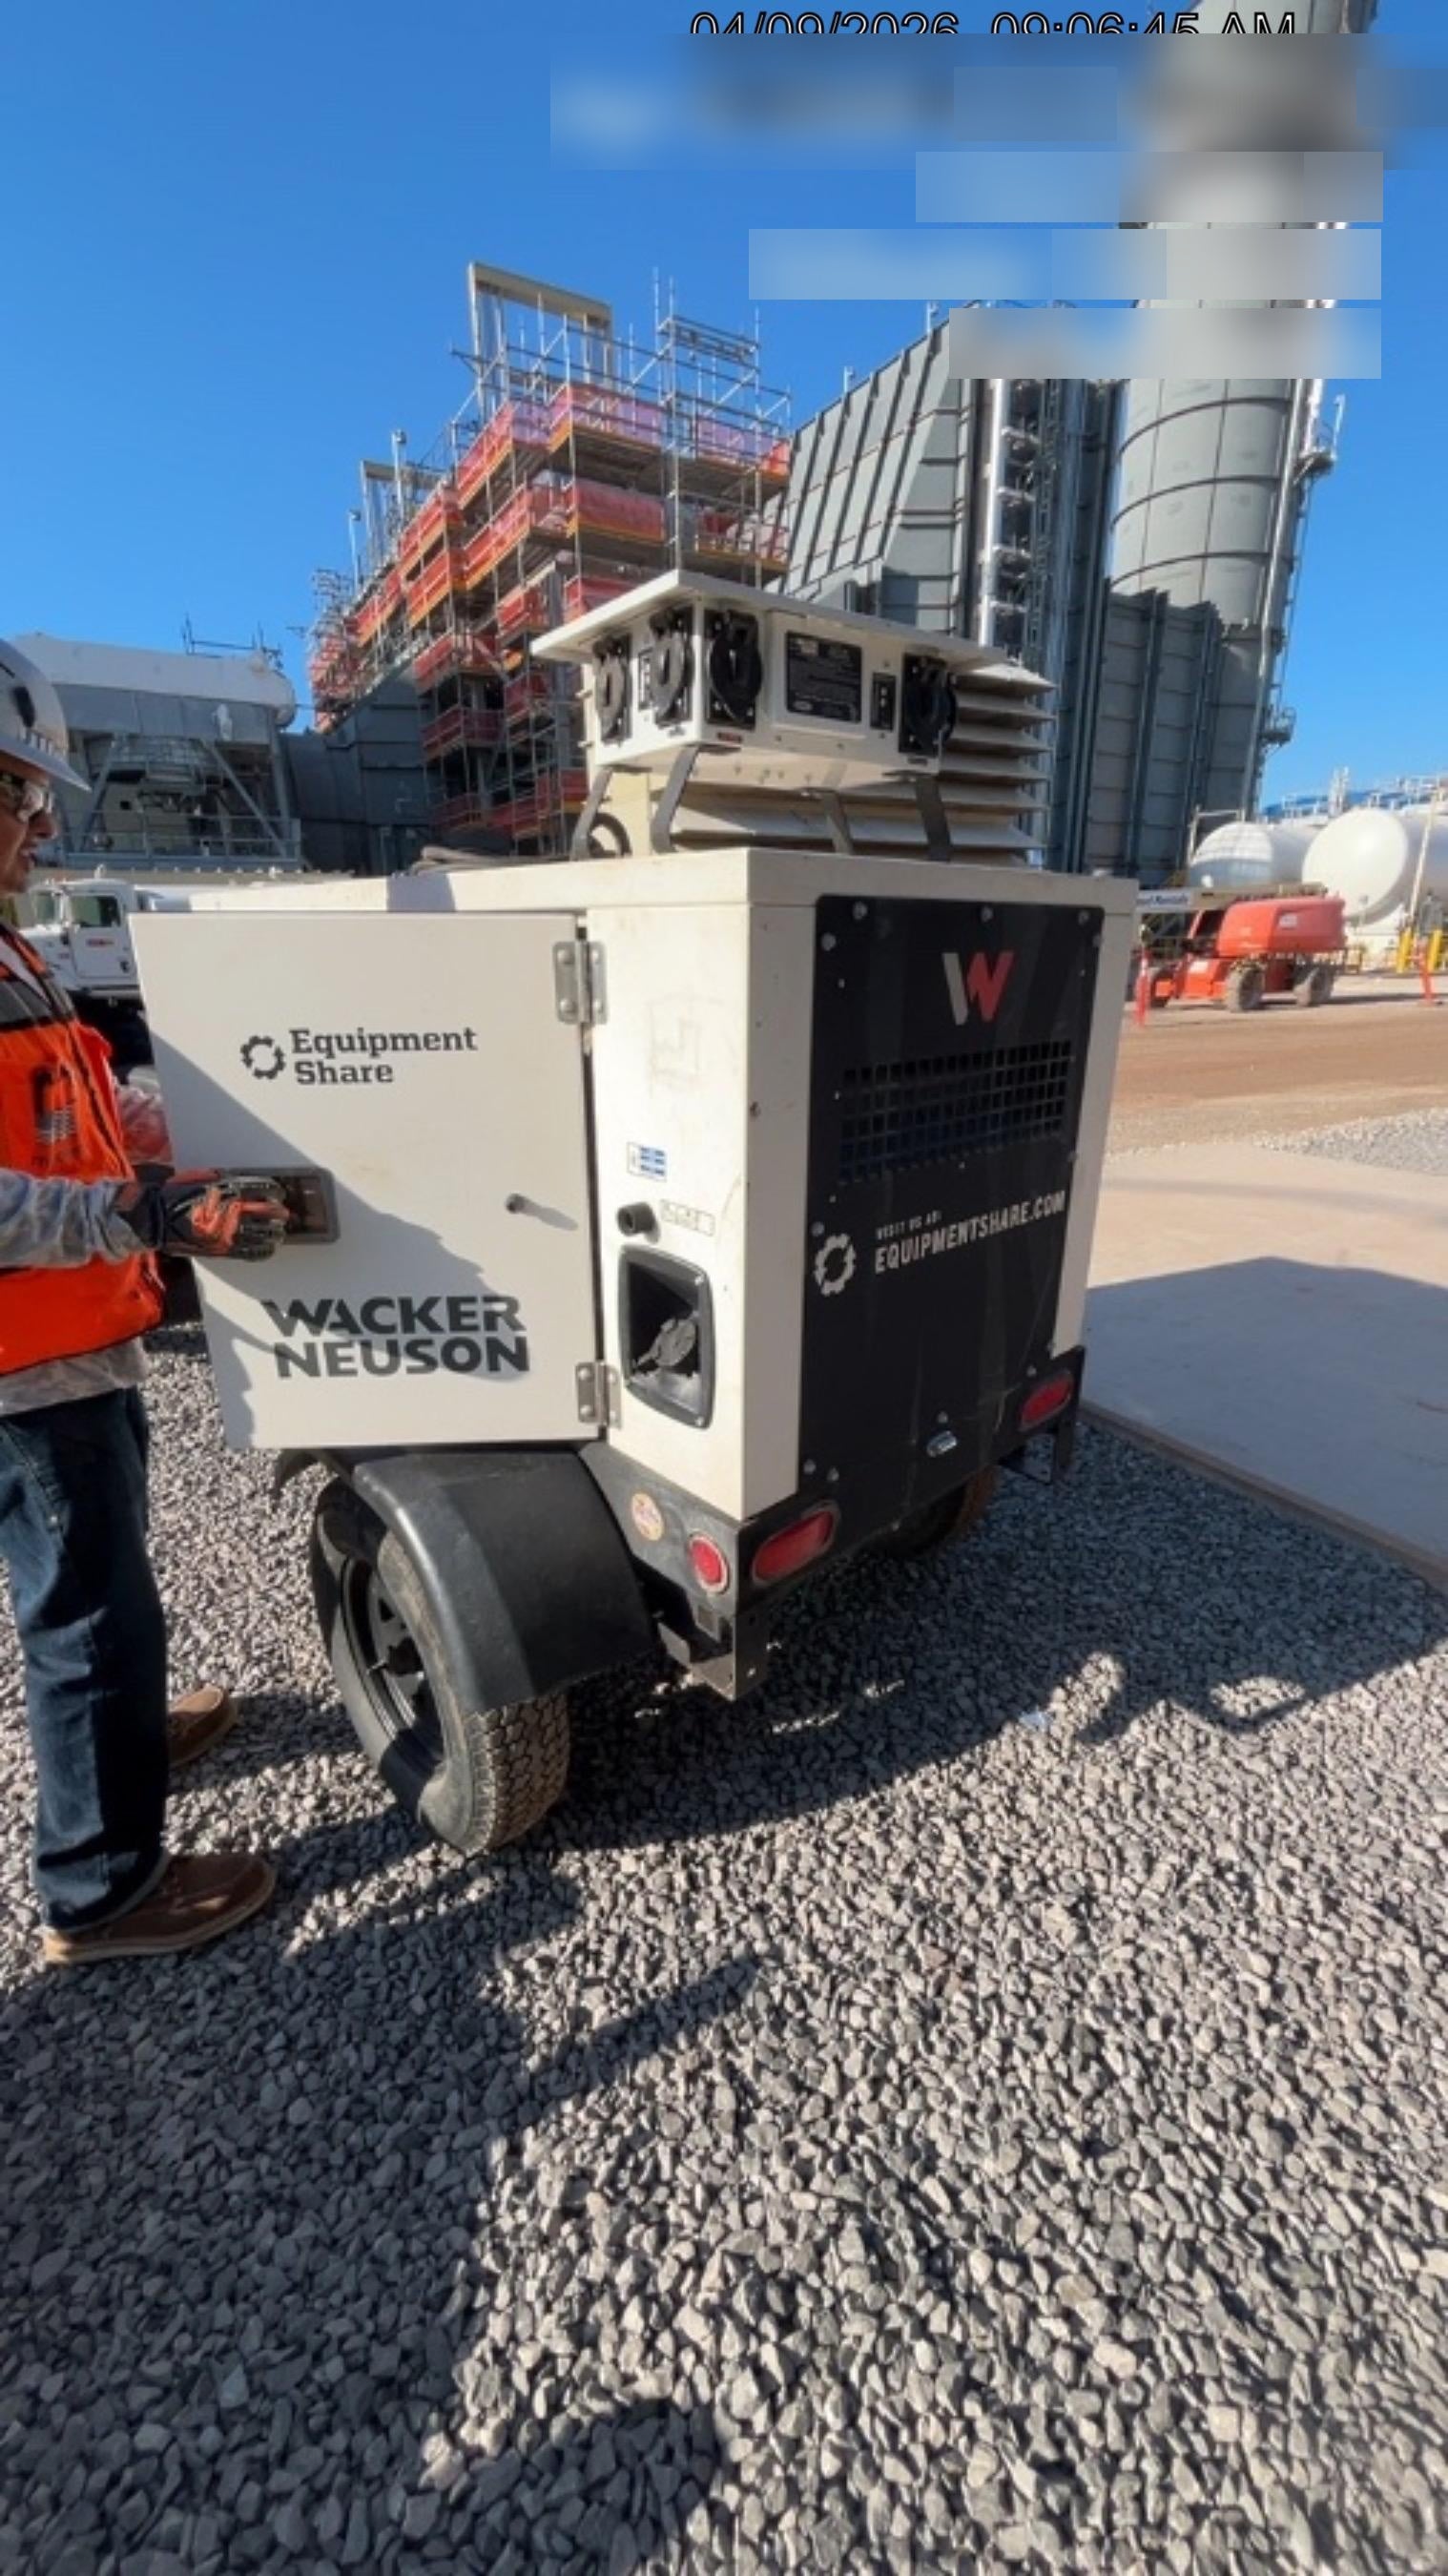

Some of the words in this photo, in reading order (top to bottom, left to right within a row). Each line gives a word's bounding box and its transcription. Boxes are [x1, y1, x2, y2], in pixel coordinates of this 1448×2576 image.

[289, 1028, 478, 1058] Equipment
[294, 1060, 394, 1086] Share
[875, 1191, 1066, 1274] EQUIPMENTSHARE.COM
[259, 1296, 527, 1338] WACKER
[274, 1336, 530, 1378] NEUSON
